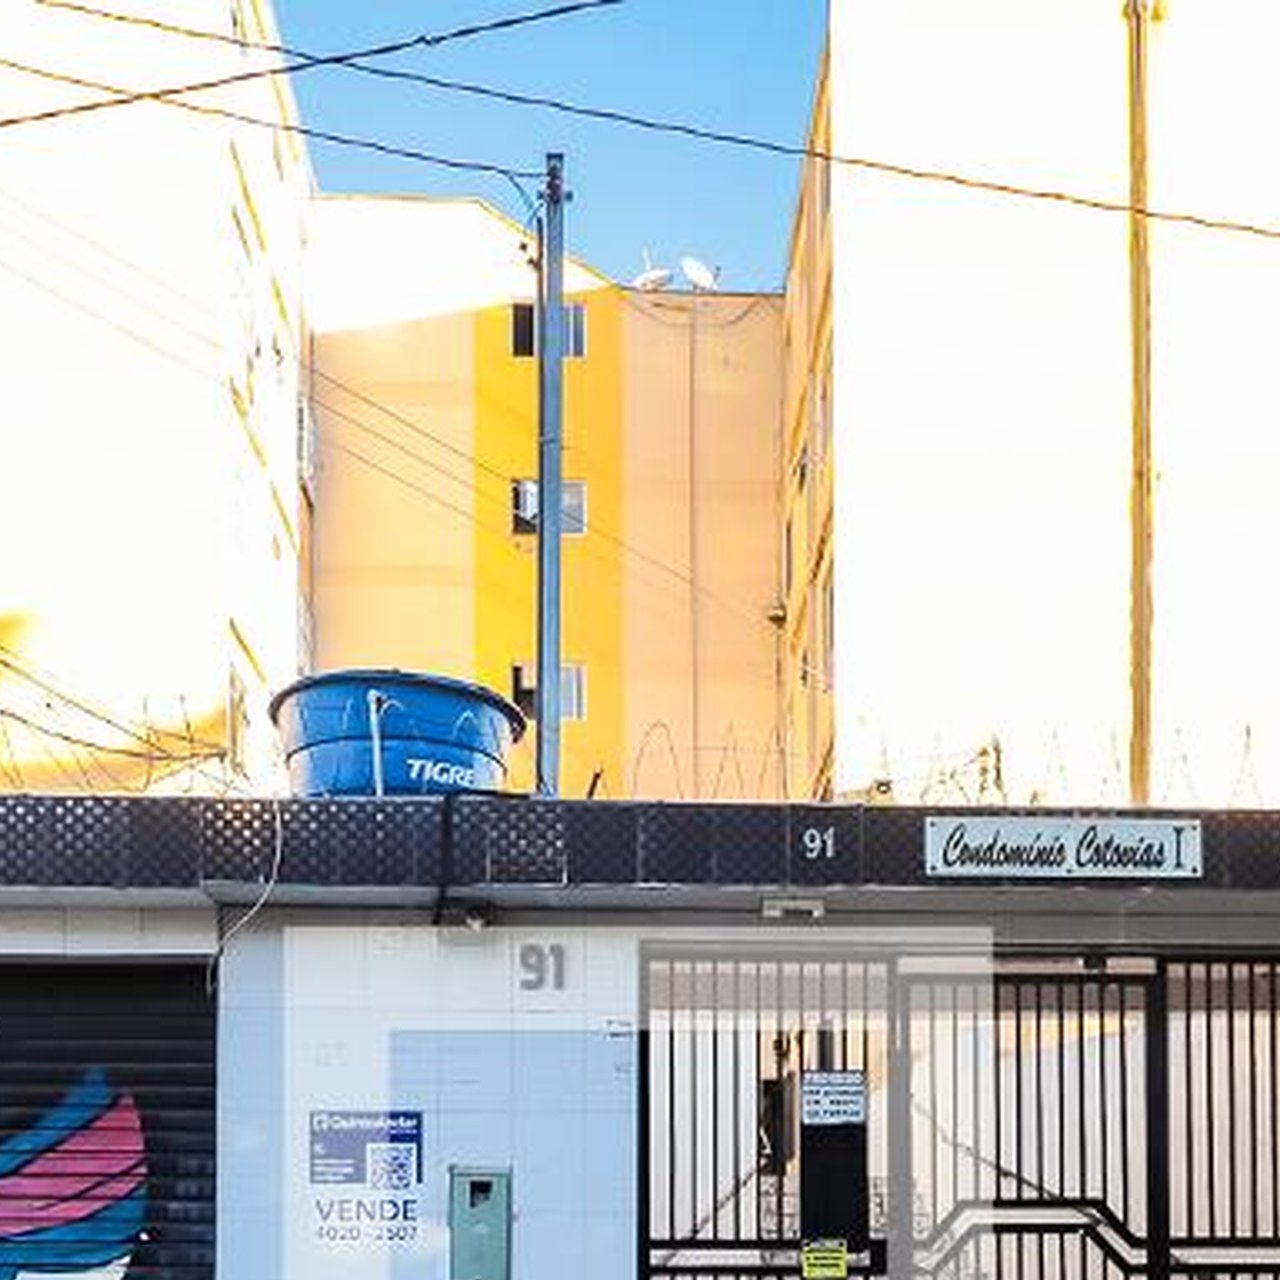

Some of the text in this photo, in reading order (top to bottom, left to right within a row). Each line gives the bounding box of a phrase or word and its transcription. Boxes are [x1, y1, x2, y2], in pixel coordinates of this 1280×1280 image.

[406, 759, 476, 787] TIGRE
[803, 826, 835, 858] 91
[520, 944, 565, 990] 91
[316, 1199, 417, 1221] VENDE
